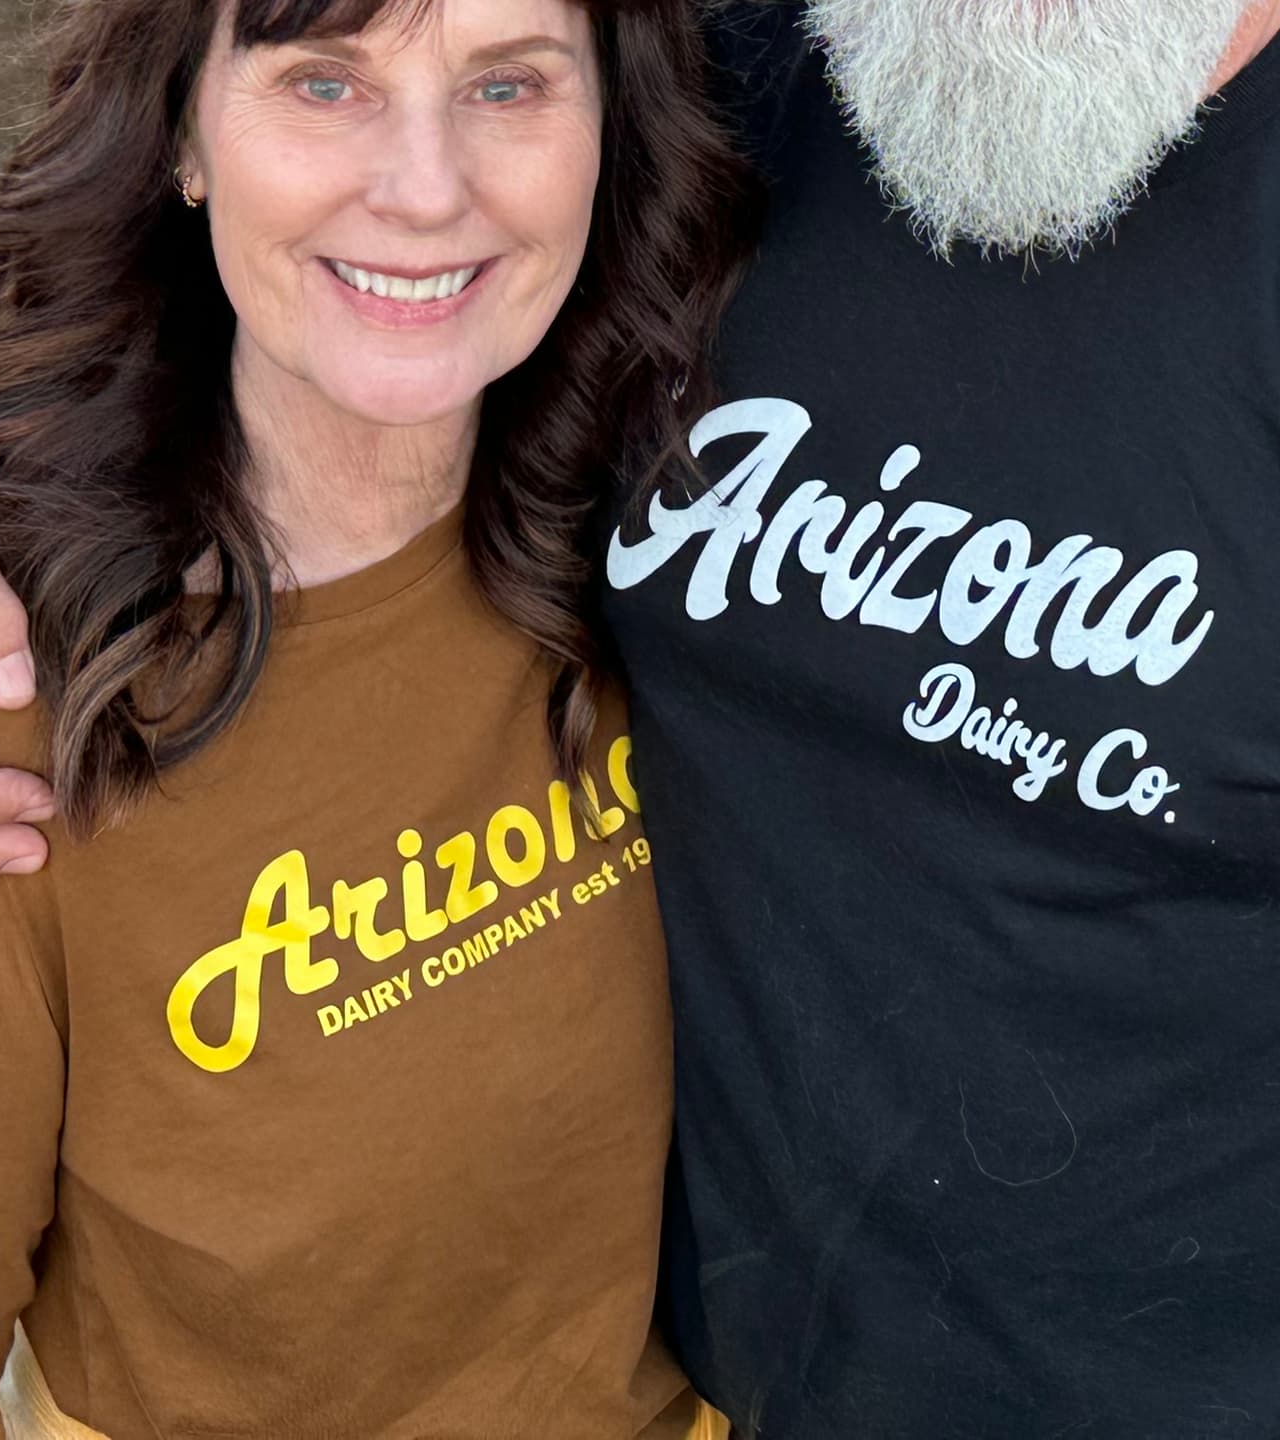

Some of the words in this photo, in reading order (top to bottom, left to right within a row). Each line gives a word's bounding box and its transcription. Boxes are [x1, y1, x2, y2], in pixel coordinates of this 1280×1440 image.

[606, 397, 1215, 686] Arizona
[902, 662, 1067, 801] Dairy
[1077, 728, 1179, 823] Co.
[316, 969, 414, 1037] DAIRY
[420, 888, 563, 987] COMPANY
[571, 860, 621, 905] est
